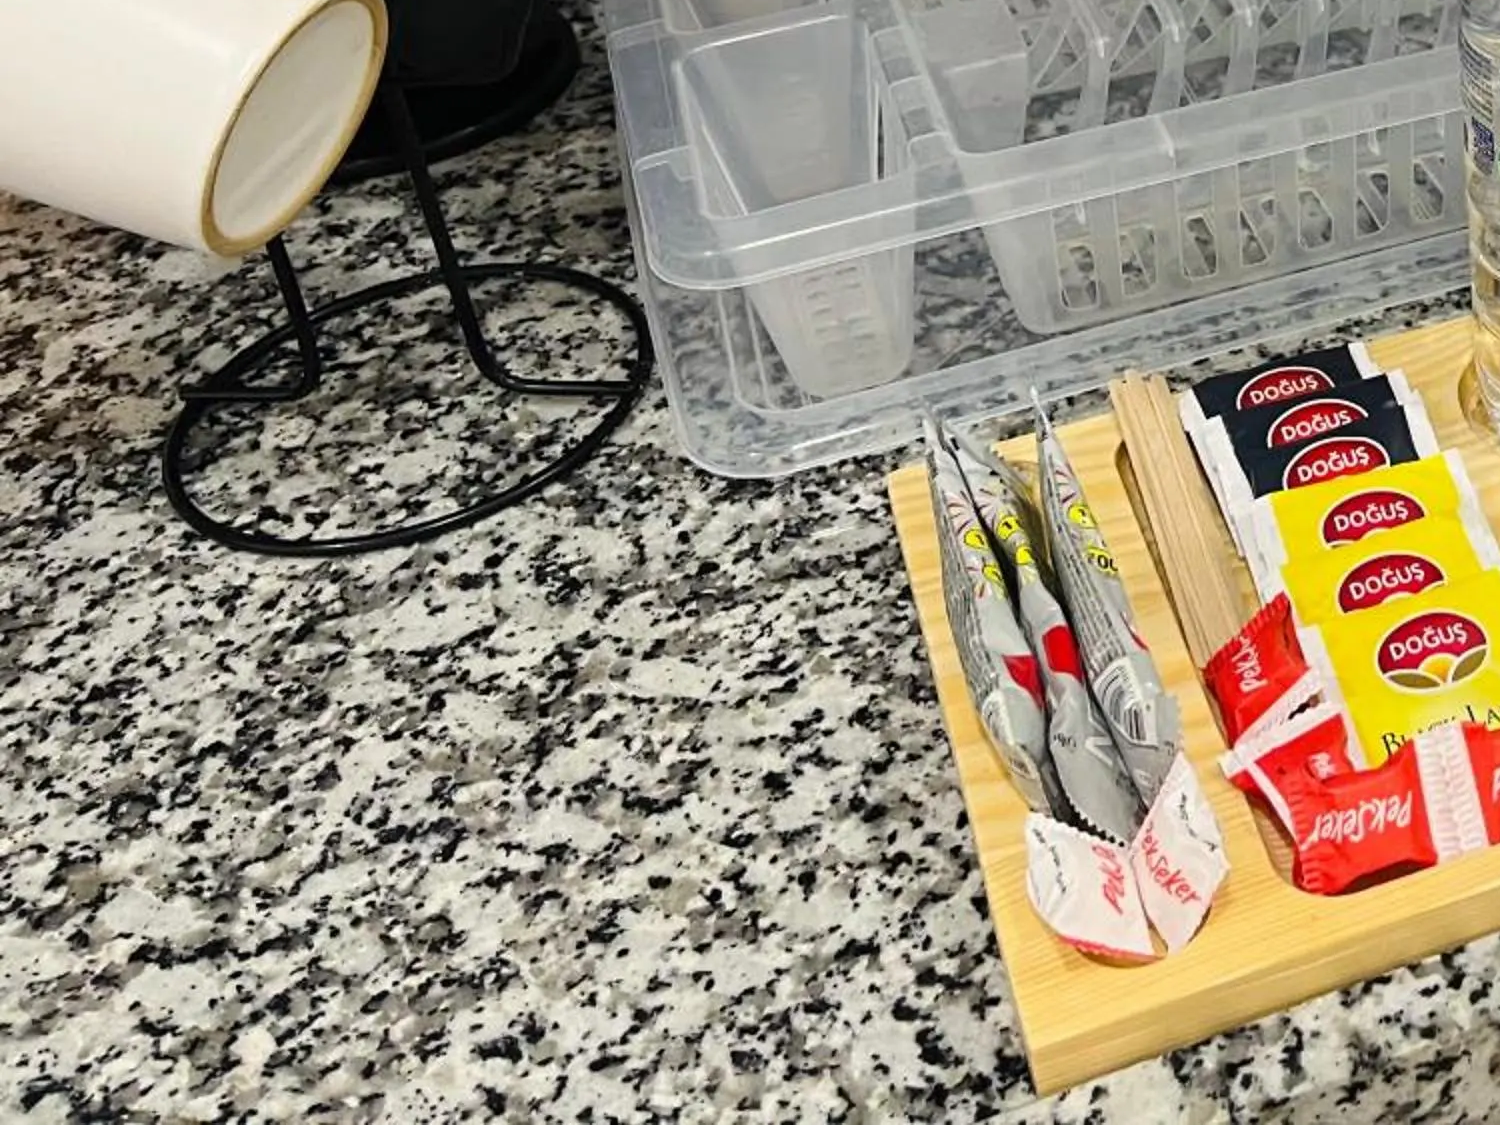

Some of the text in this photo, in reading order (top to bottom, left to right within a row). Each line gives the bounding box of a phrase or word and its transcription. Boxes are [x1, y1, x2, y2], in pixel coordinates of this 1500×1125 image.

[1250, 375, 1319, 404] DOĞUŞ
[1297, 446, 1370, 482] DOĞUŞ
[1334, 500, 1409, 532] DOĞUŞ
[1349, 563, 1425, 600] DOĞUŞ
[1389, 622, 1467, 661] DOĞUŞ
